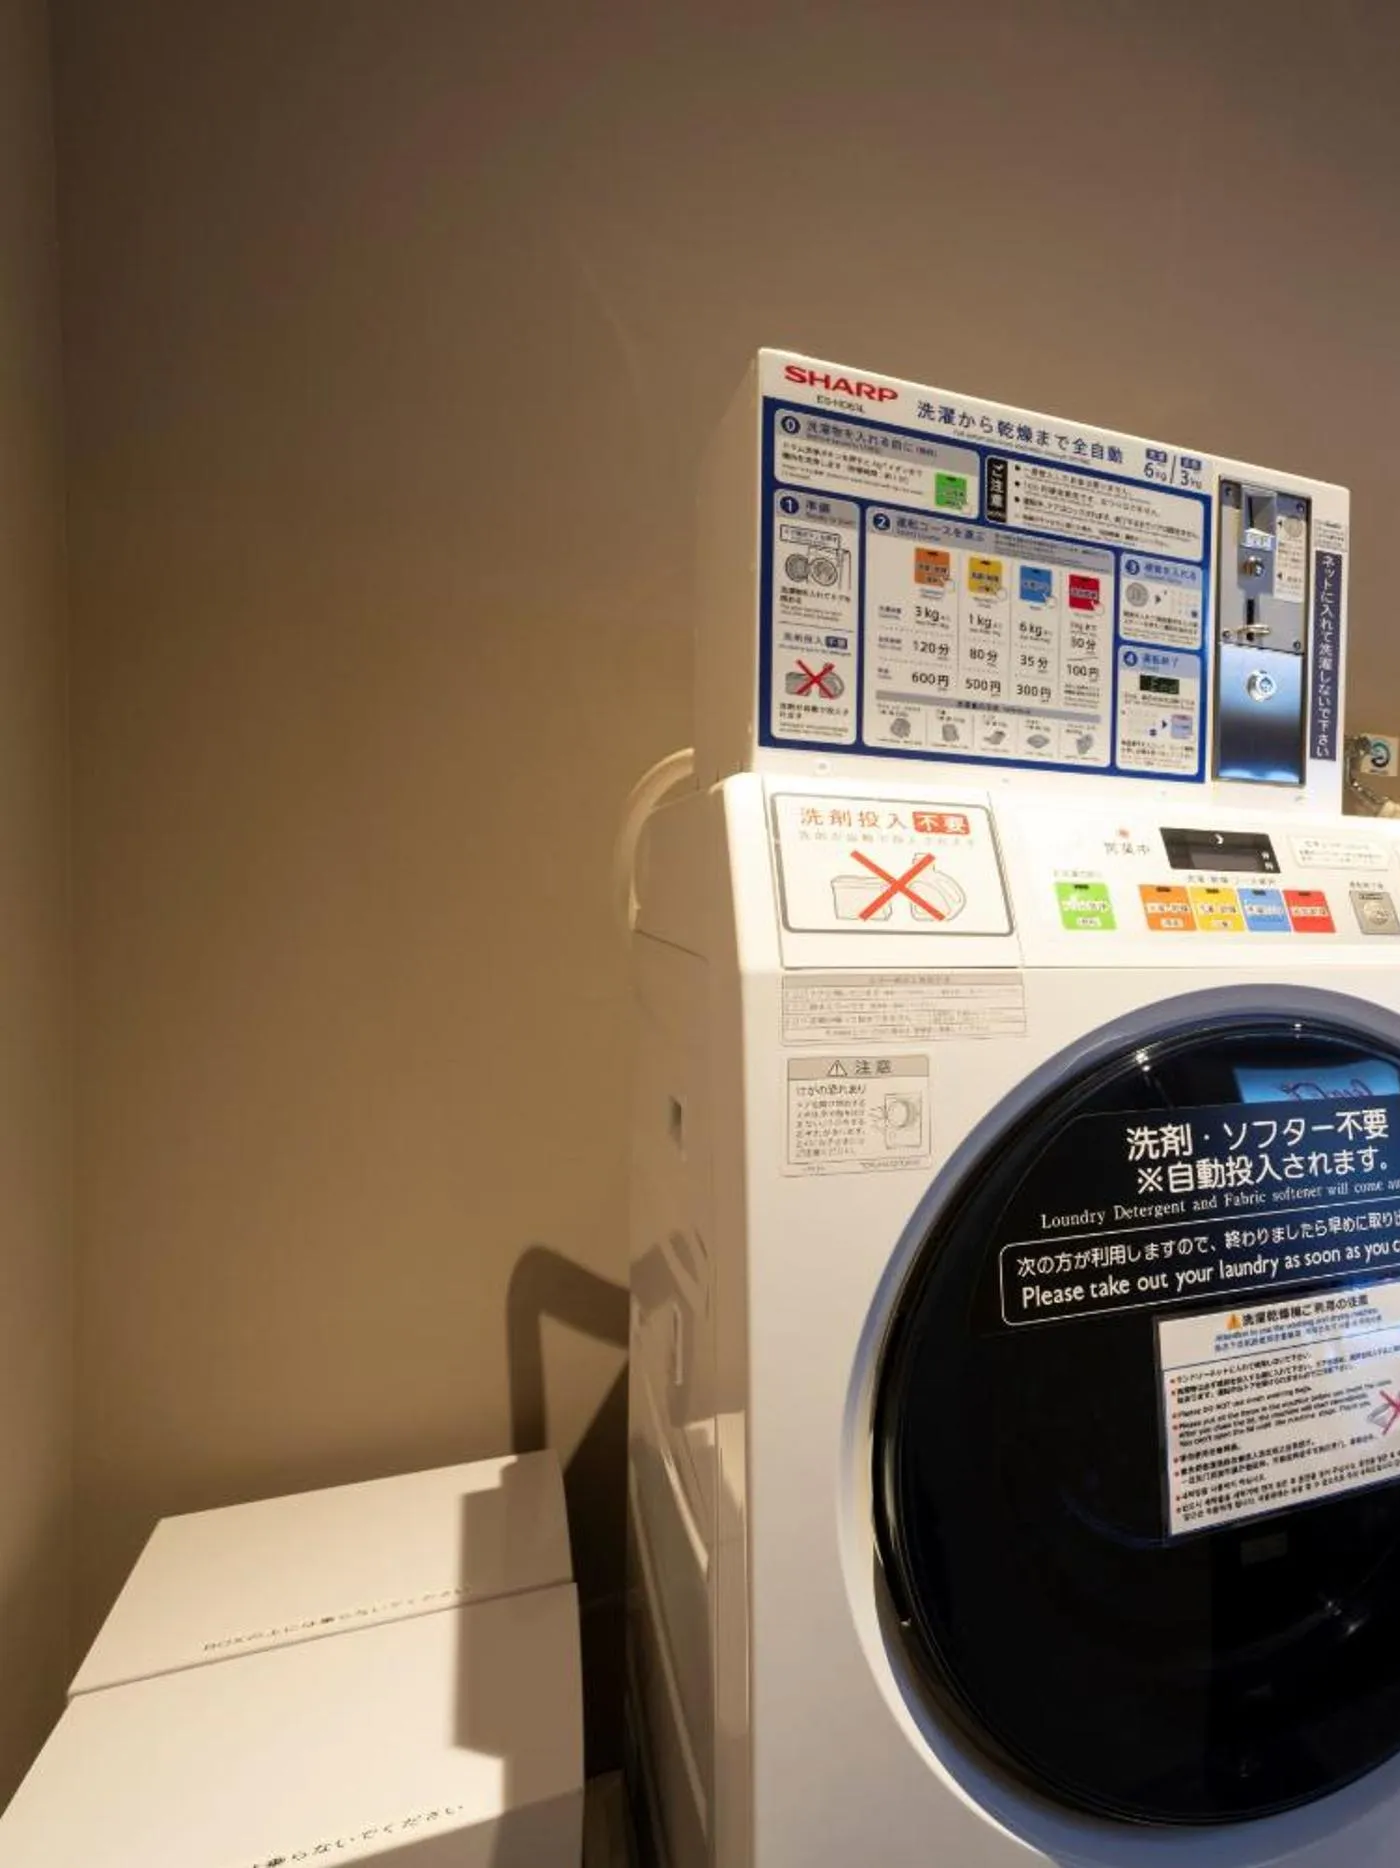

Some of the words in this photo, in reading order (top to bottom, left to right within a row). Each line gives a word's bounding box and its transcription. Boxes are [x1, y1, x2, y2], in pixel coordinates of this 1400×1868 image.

[784, 365, 899, 402] SHARP
[916, 400, 1123, 464] 洗濯から乾燥まで全自動
[1066, 664, 1100, 679] 100円
[1316, 555, 1336, 757] ネットに入れて洗濯しないで下さい
[911, 672, 950, 688] 600円
[965, 678, 1001, 694] 500円
[1016, 684, 1052, 699] 300円
[800, 807, 907, 830] 洗剤投入
[919, 814, 965, 833] 不要
[1126, 1108, 1389, 1162] 洗剤・ソフター不要
[1136, 1144, 1389, 1196] ※自動投入されます。
[1040, 1206, 1106, 1231] Loundry
[1114, 1199, 1187, 1223] Detergent
[1193, 1195, 1218, 1211] and
[1224, 1190, 1267, 1208] Fabric
[1272, 1184, 1323, 1204] softener
[1327, 1180, 1349, 1196] will
[1354, 1181, 1384, 1195] come
[1021, 1284, 1085, 1310] Please
[1090, 1278, 1131, 1299] take
[1137, 1275, 1169, 1292] out
[1176, 1268, 1213, 1292] your
[1219, 1255, 1279, 1282] laundry
[1284, 1255, 1301, 1270] as
[1304, 1248, 1341, 1267] soon
[1346, 1246, 1361, 1260] as
[1365, 1242, 1389, 1264] you
